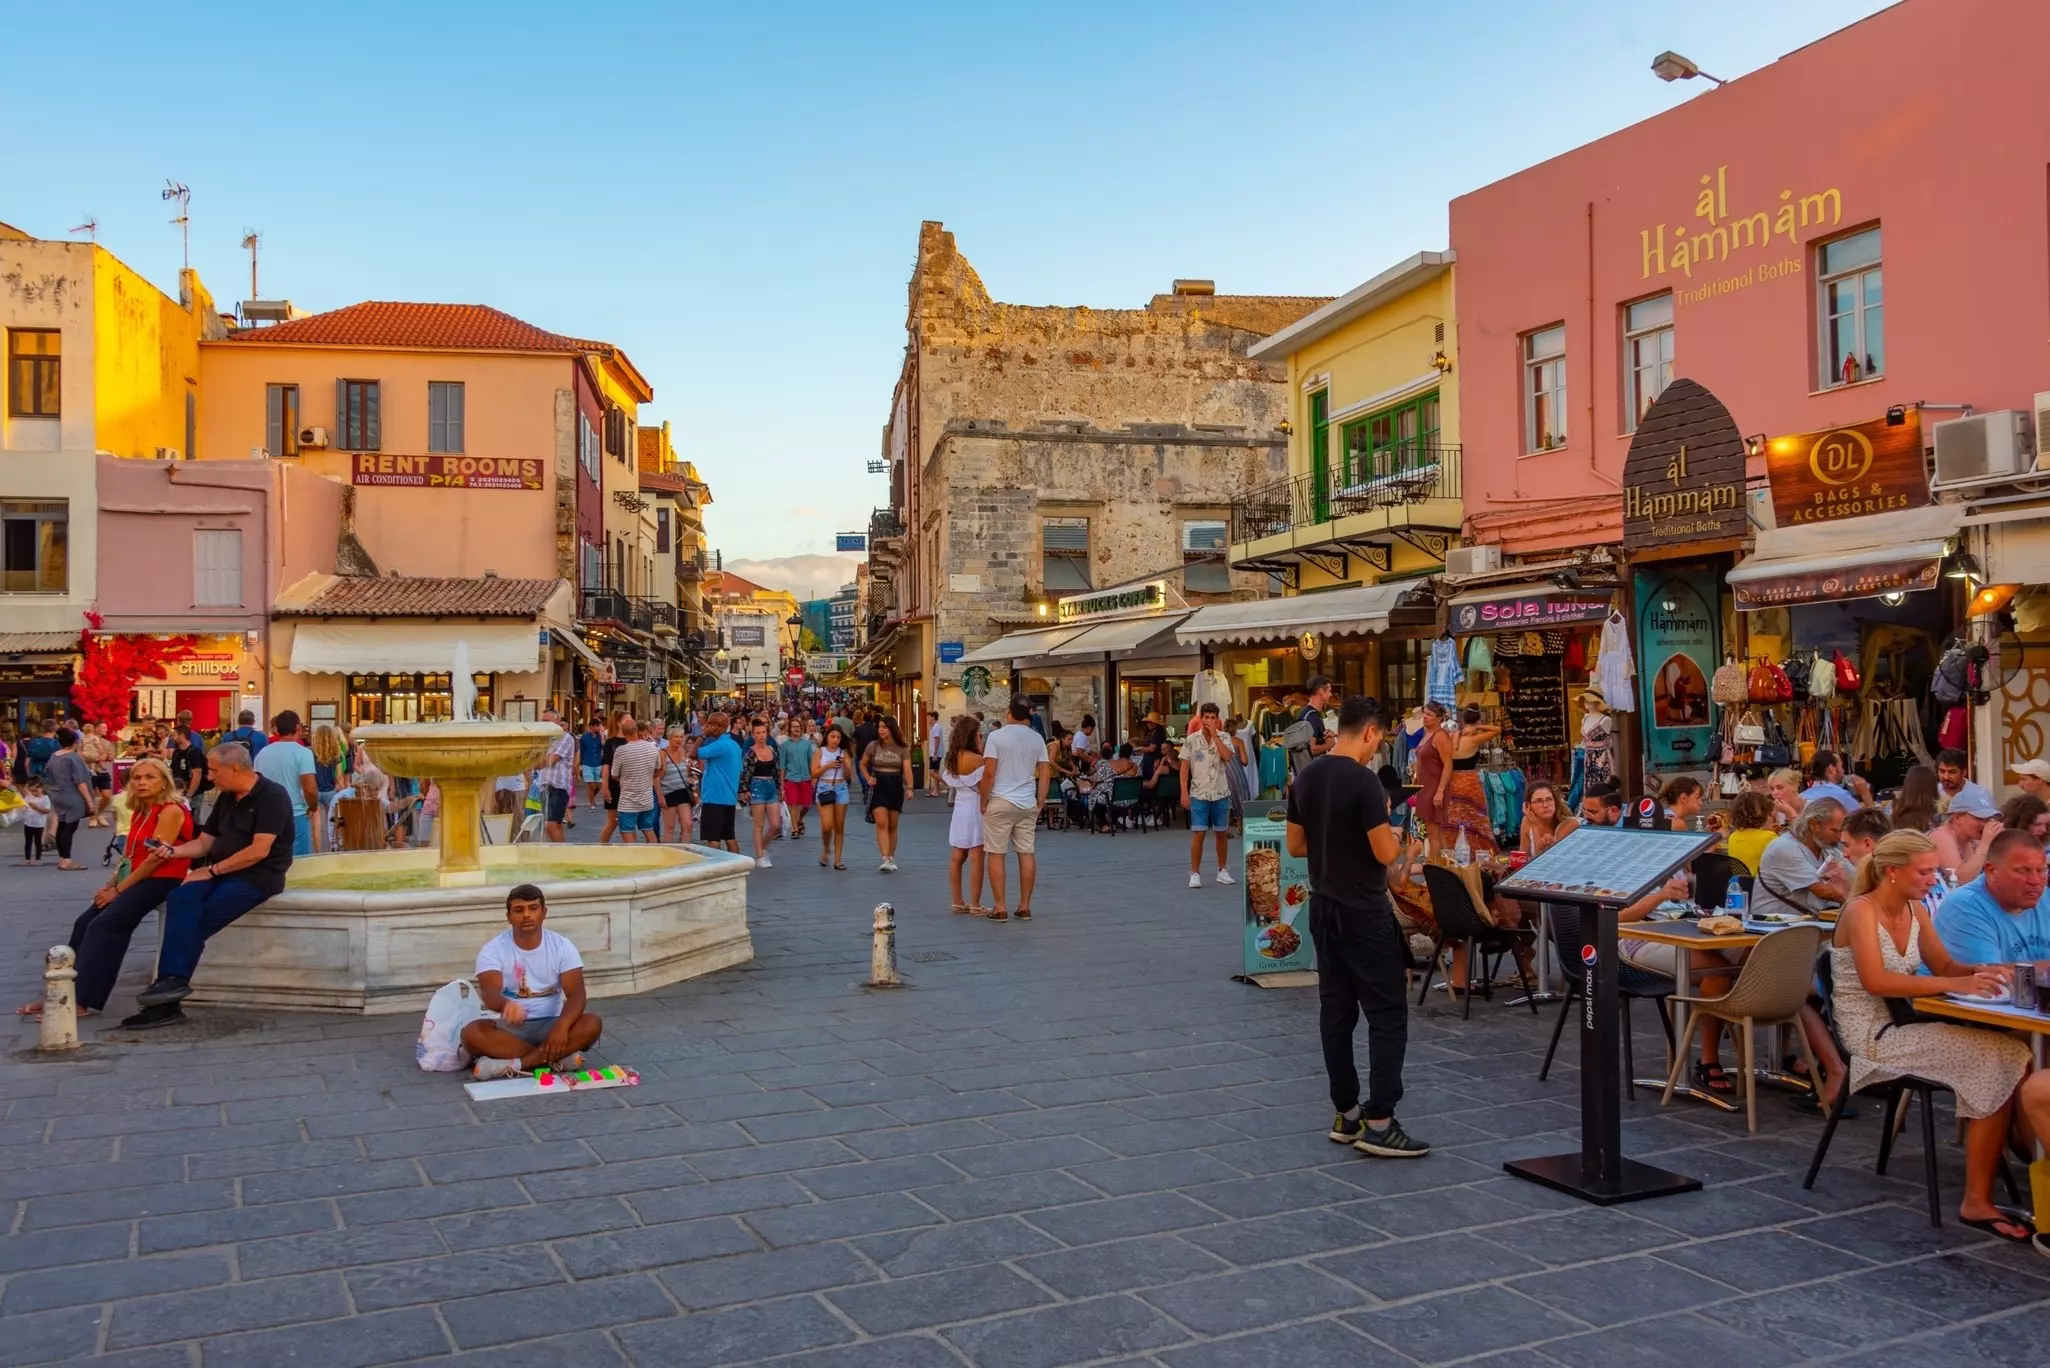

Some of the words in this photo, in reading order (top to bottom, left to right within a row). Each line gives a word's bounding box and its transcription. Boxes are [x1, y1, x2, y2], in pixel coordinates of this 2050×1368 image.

[1675, 268, 1753, 307] Traditional
[1758, 256, 1802, 283] Baths
[359, 455, 430, 474] RENT
[443, 458, 537, 476] ROOMS
[1826, 442, 1859, 472] DL
[356, 474, 370, 484] AIR
[372, 474, 424, 485] CONDITIONED
[1814, 486, 1860, 505] BAGS
[1871, 482, 1883, 495] &
[1793, 494, 1909, 522] ACCESSORIES
[1651, 522, 1695, 538] Traditional
[1696, 520, 1721, 533] Baths
[1859, 574, 1888, 584] BAGS
[1059, 594, 1118, 617] STARBUCKS
[1752, 589, 1817, 602] ACCESSORIES
[1481, 600, 1540, 621] Sola
[1495, 618, 1529, 628] Accessories
[1530, 615, 1554, 624] Piercing
[1562, 612, 1585, 620] clothes
[179, 660, 240, 675] chillbox
[1258, 961, 1278, 971] Gyros
[1585, 997, 1594, 1029] pepsi
